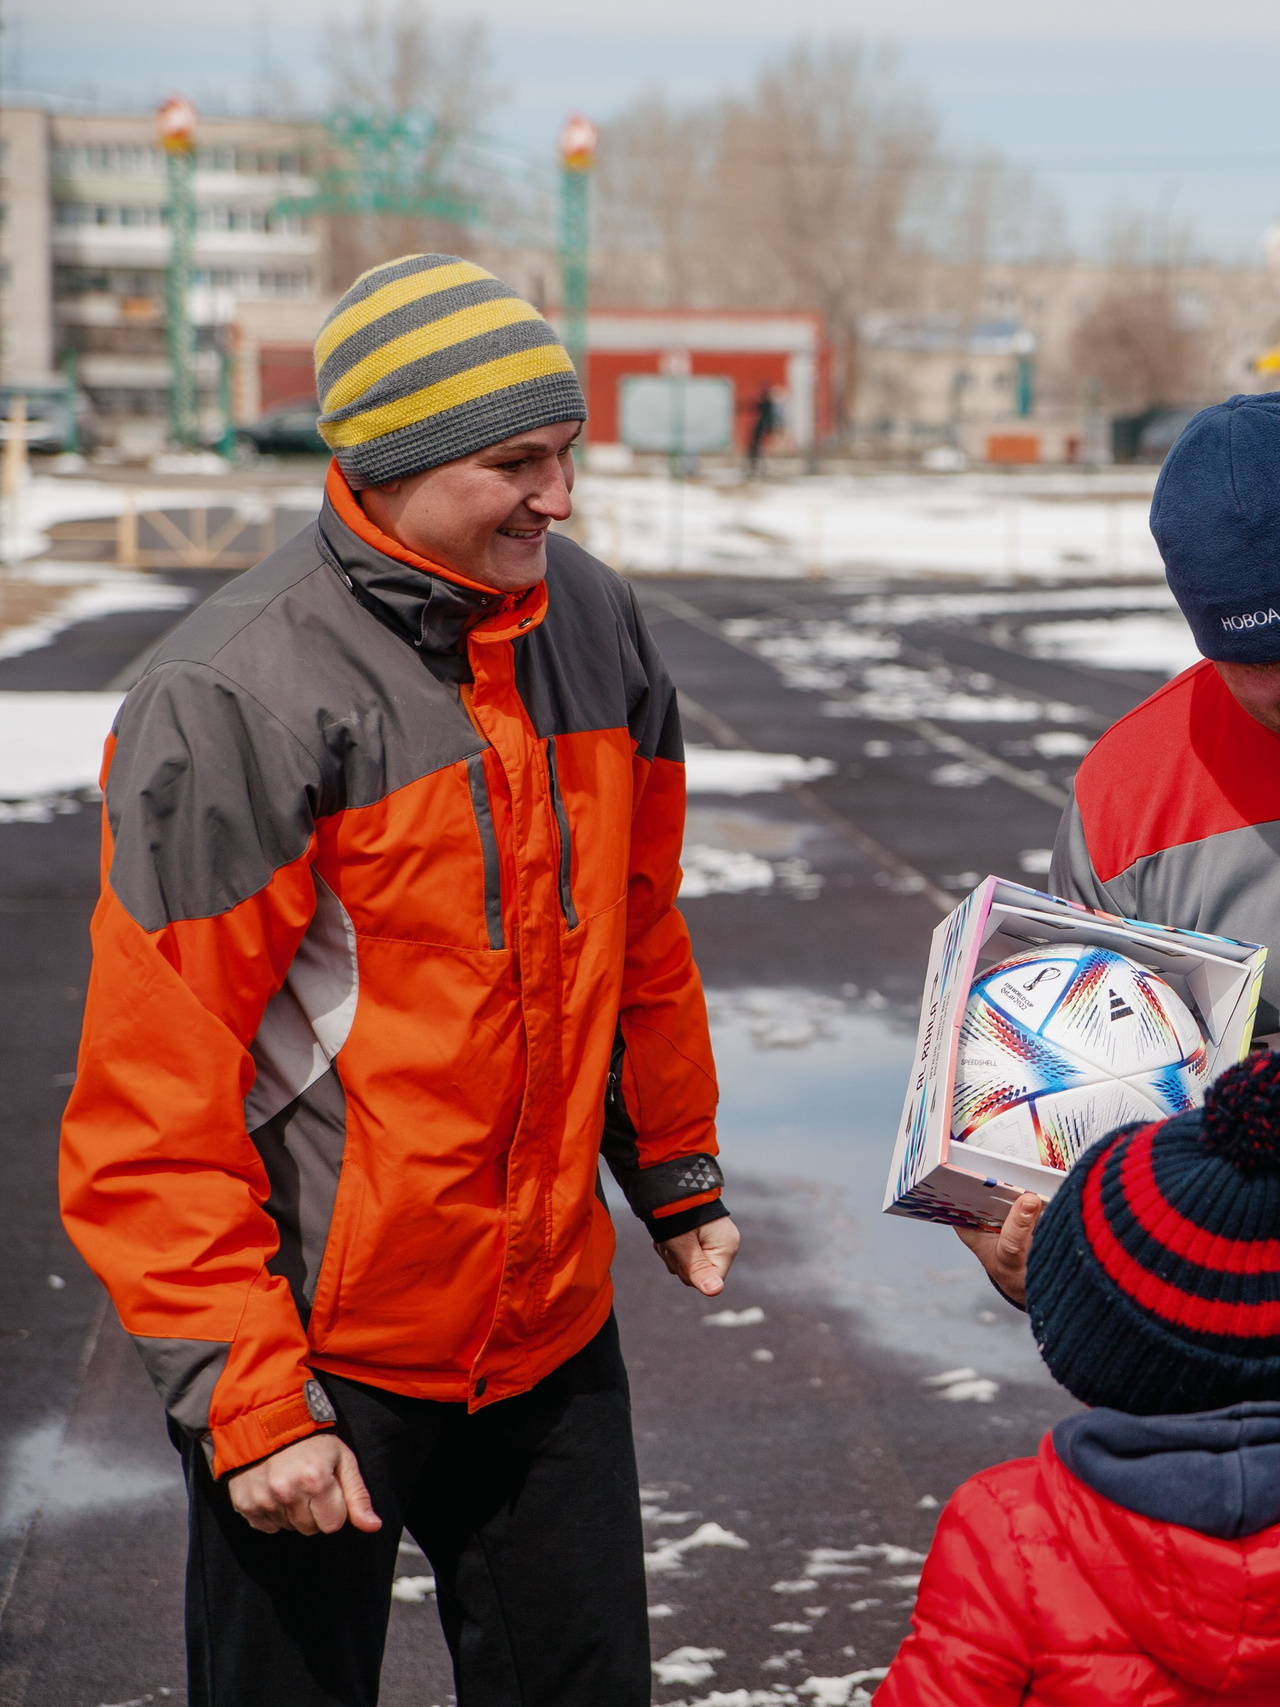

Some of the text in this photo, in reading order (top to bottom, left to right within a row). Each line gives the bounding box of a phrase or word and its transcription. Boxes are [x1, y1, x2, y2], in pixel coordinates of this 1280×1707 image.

[916, 1001, 938, 1091] AL RIHLA
[960, 1058, 997, 1067] SPEEDSHELL
